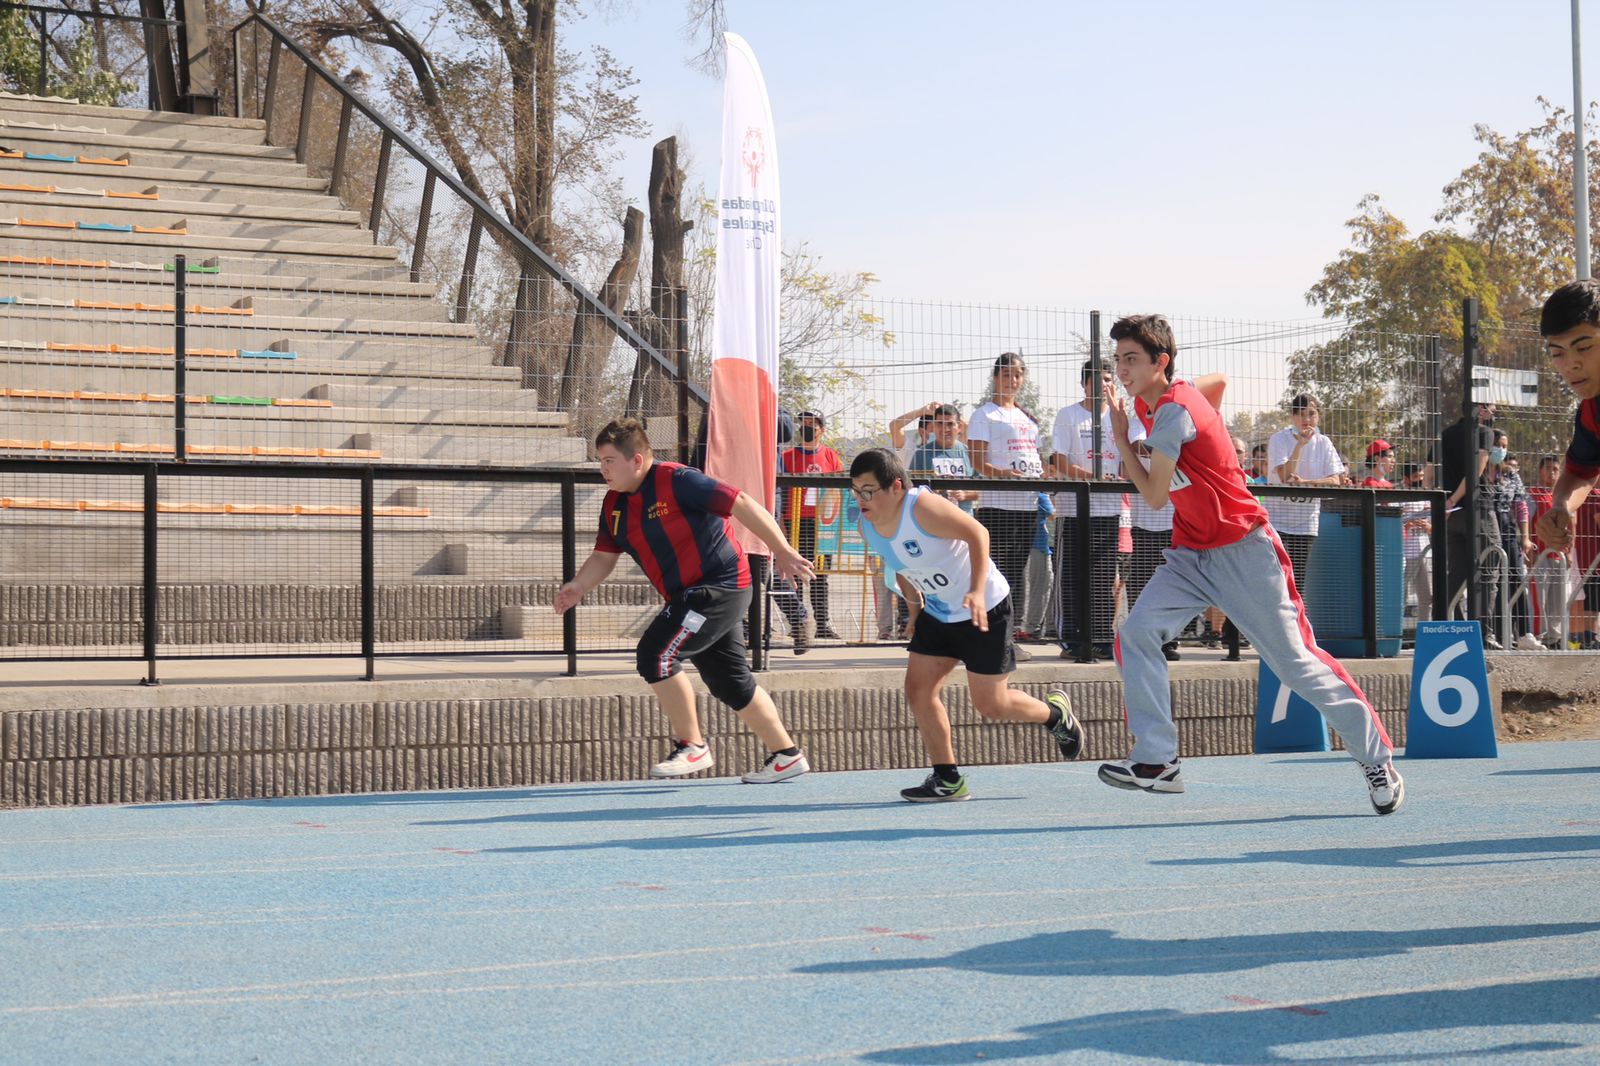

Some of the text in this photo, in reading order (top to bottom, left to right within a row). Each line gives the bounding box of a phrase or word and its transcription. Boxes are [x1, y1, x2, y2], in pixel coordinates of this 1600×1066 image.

[936, 464, 964, 475] 1104
[612, 510, 621, 537] 7
[1450, 625, 1474, 635] Sport
[1420, 640, 1480, 727] 6
